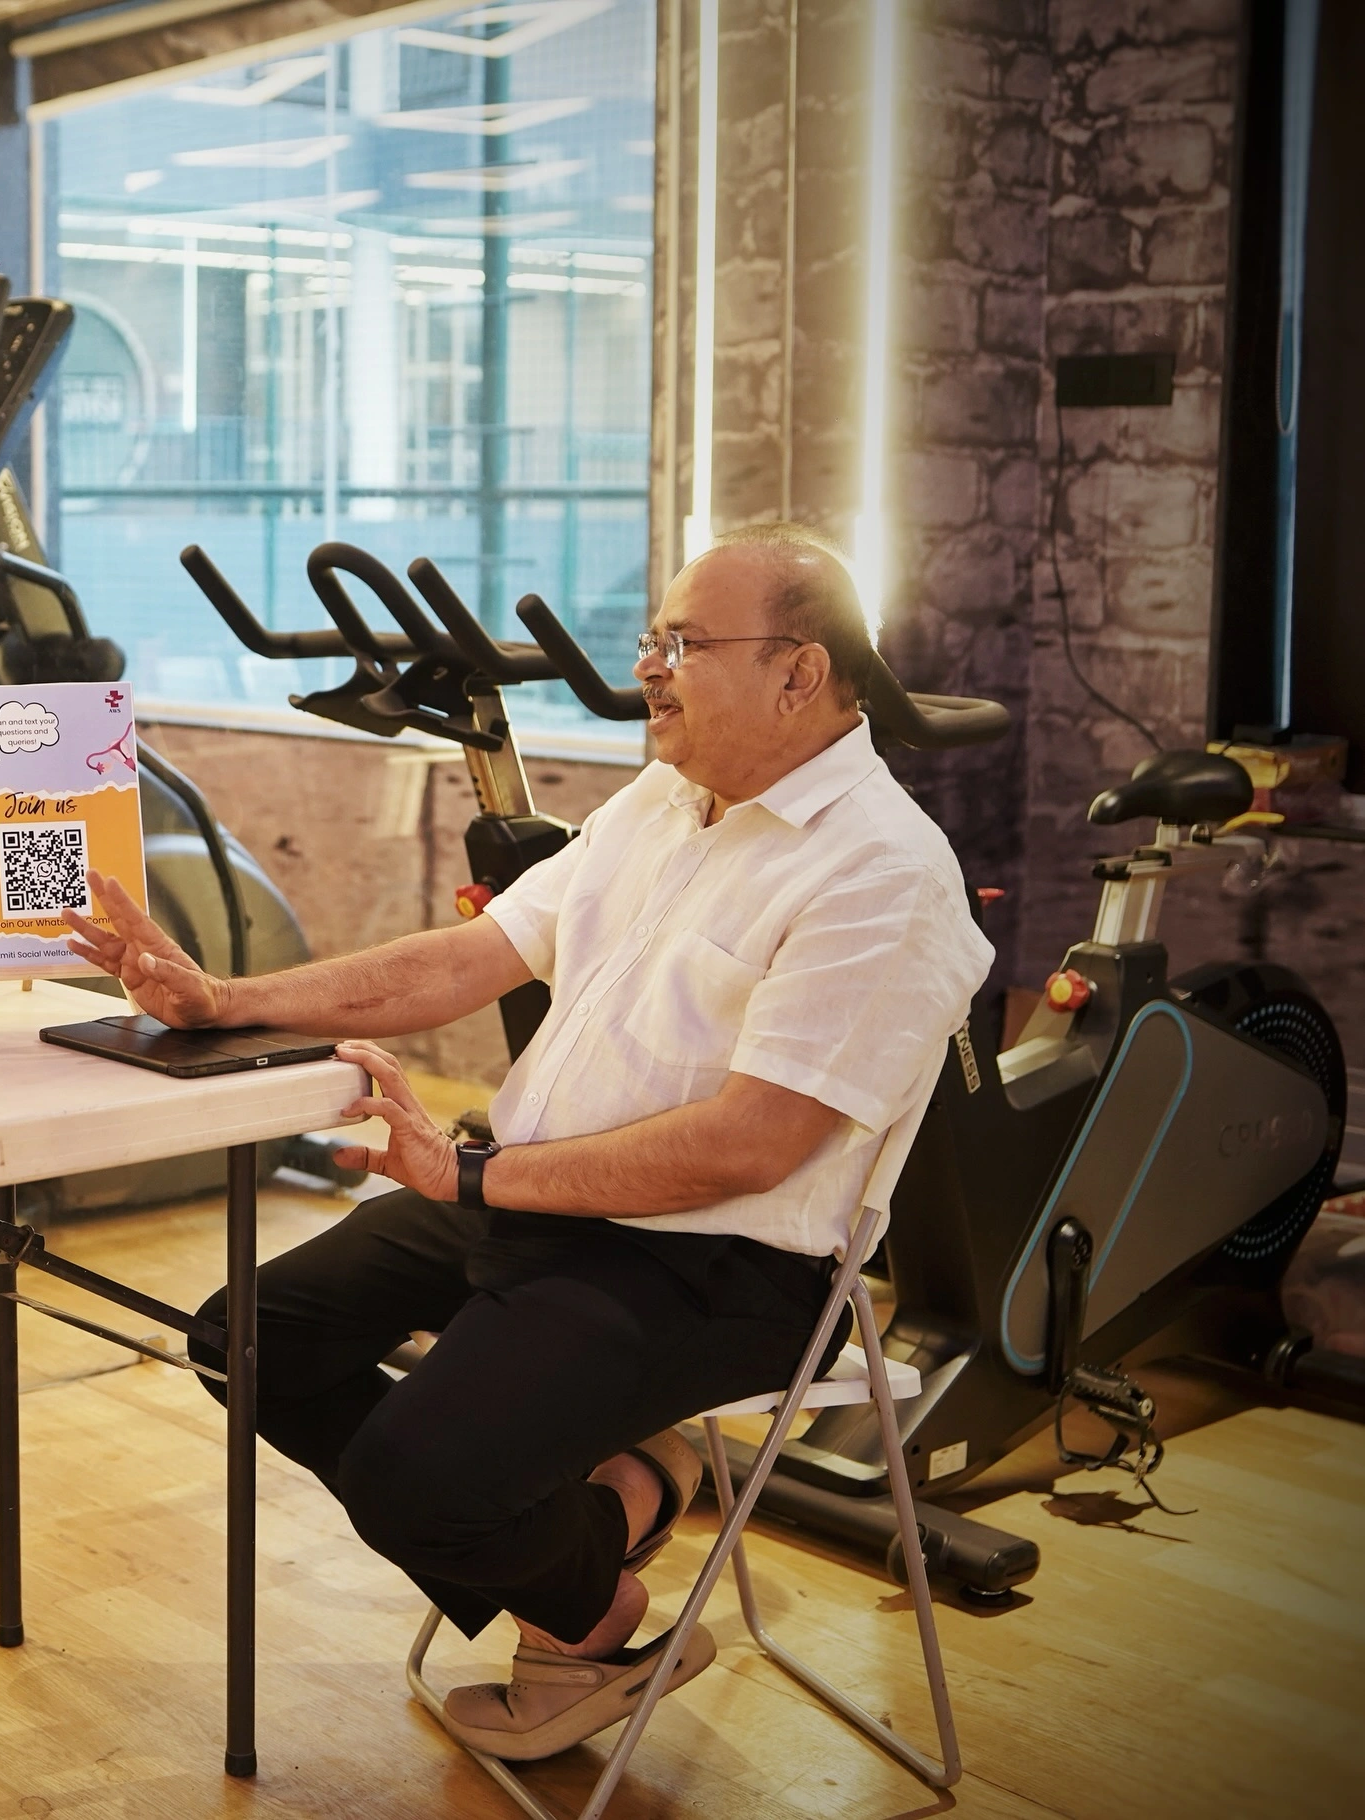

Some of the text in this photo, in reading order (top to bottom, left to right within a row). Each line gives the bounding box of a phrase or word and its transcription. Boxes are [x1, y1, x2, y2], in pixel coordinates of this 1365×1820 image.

[39, 718, 56, 728] your
[7, 739, 37, 747] queries!
[4, 791, 78, 819] Join us
[16, 919, 34, 928] Our
[36, 918, 68, 927] Whats
[17, 950, 42, 958] Social
[43, 950, 74, 958] Welfare
